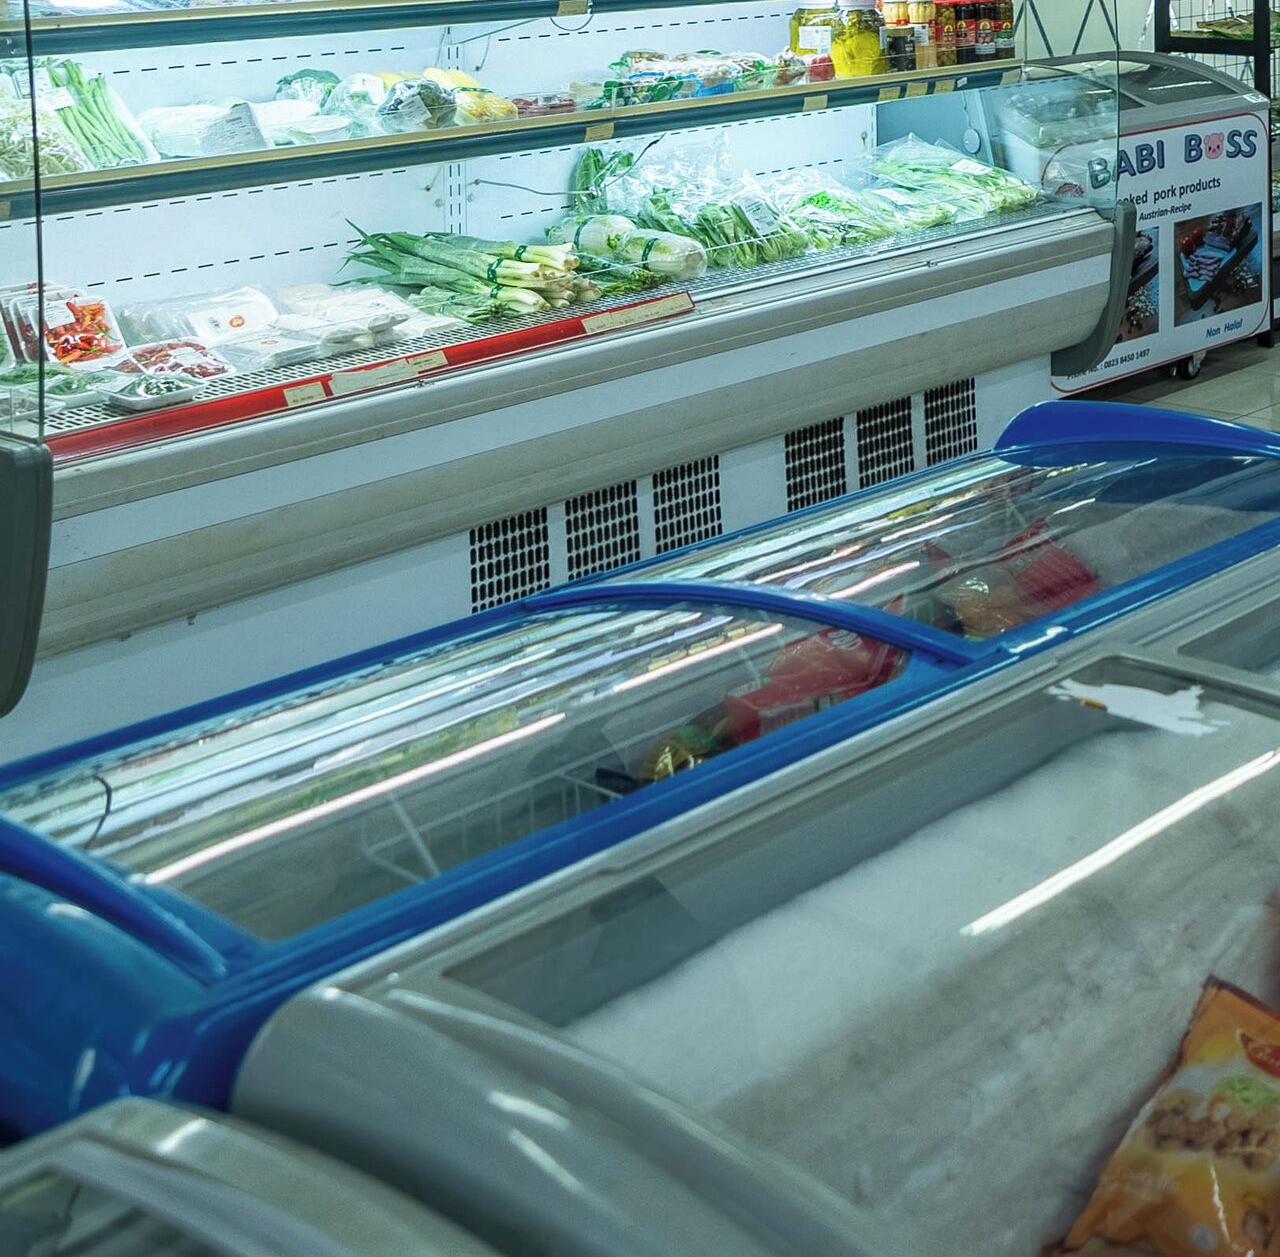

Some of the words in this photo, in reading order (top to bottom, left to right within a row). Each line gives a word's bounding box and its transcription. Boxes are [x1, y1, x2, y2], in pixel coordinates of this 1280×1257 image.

[1088, 139, 1165, 189] BABI
[1153, 184, 1178, 208] pork
[1179, 175, 1221, 200] products
[1139, 201, 1192, 222] Austrian-Recipe
[1206, 326, 1221, 339] Non
[1223, 317, 1243, 335] Halal
[1103, 358, 1119, 369] 0823
[1120, 353, 1135, 365] 8450
[1136, 348, 1150, 361] 1497
